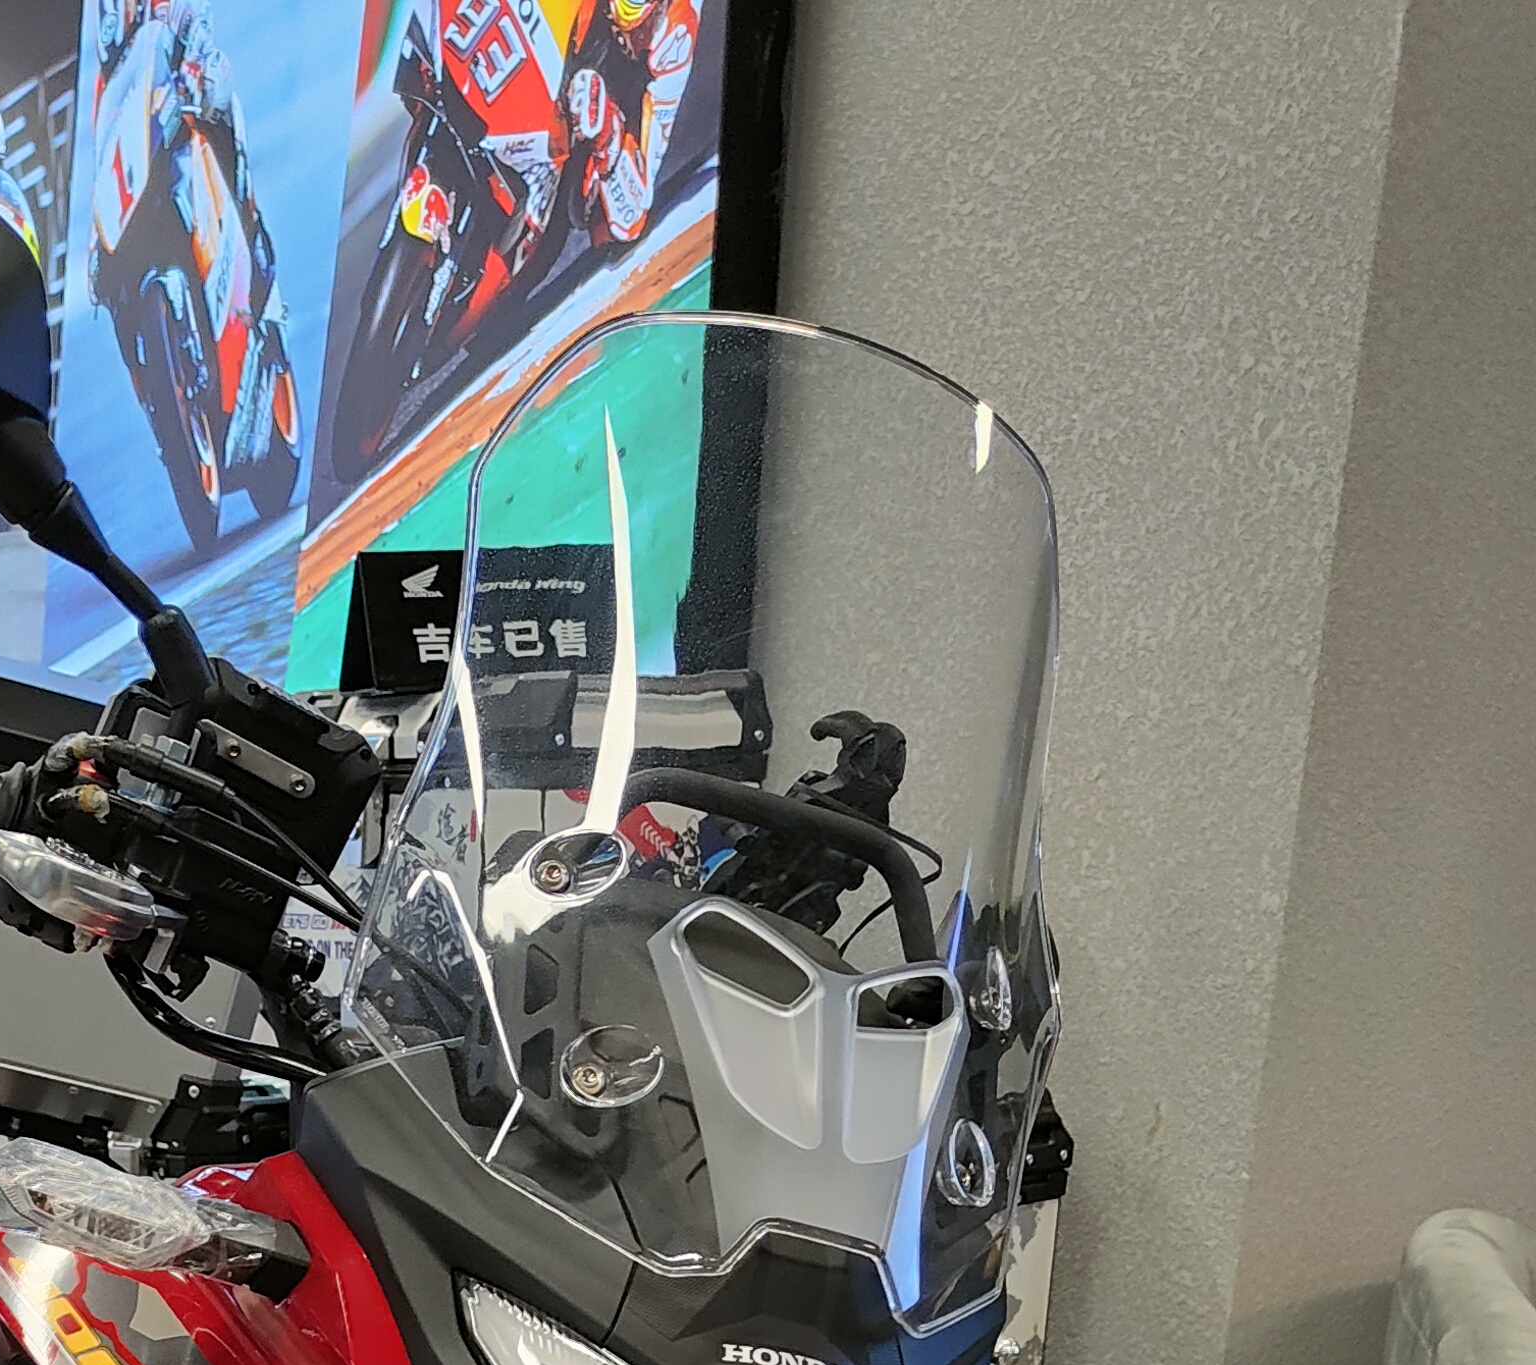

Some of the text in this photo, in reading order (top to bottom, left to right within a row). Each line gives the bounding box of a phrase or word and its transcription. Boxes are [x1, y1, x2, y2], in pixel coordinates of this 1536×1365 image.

[475, 579, 532, 594] onda
[411, 618, 589, 664] 吉车已售
